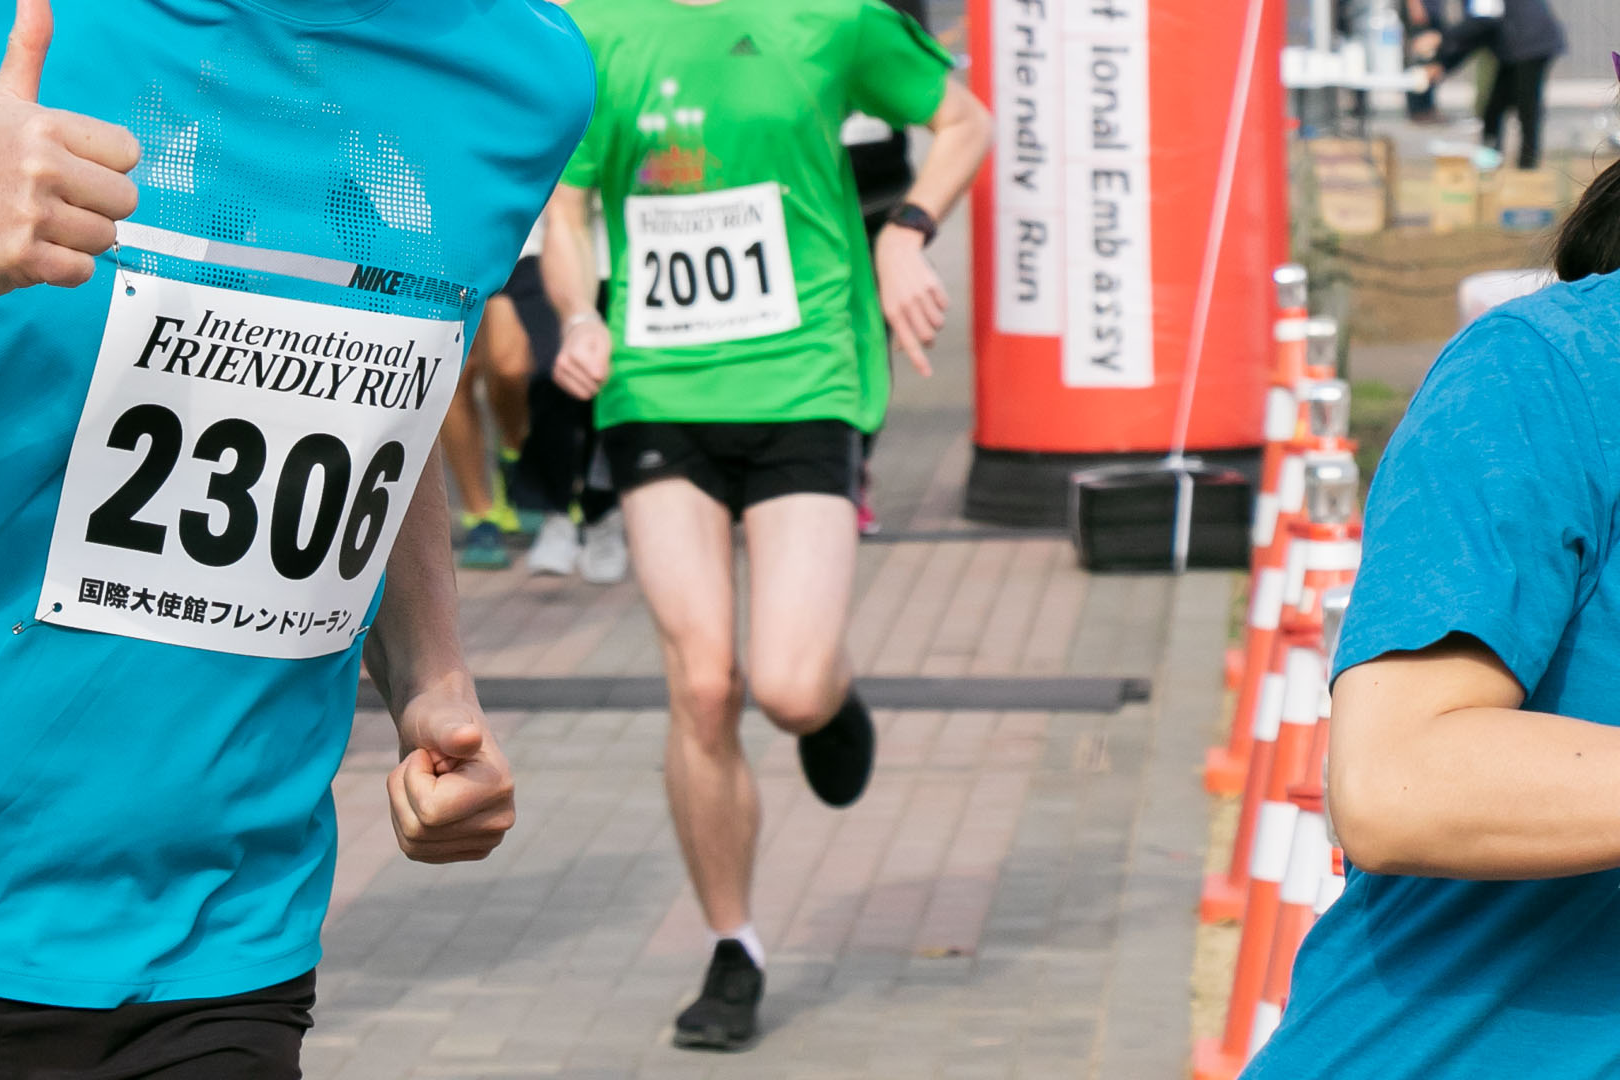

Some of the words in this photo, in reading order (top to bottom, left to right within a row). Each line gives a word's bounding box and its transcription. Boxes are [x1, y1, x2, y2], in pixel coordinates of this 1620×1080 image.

[645, 241, 770, 308] 2001
[1017, 219, 1048, 303] Run
[132, 315, 358, 401] FRIENDLY
[352, 356, 442, 410] RUN
[194, 309, 416, 369] International
[84, 403, 406, 581] 2306
[77, 576, 353, 637] 国際大使館フレンドリーラン
